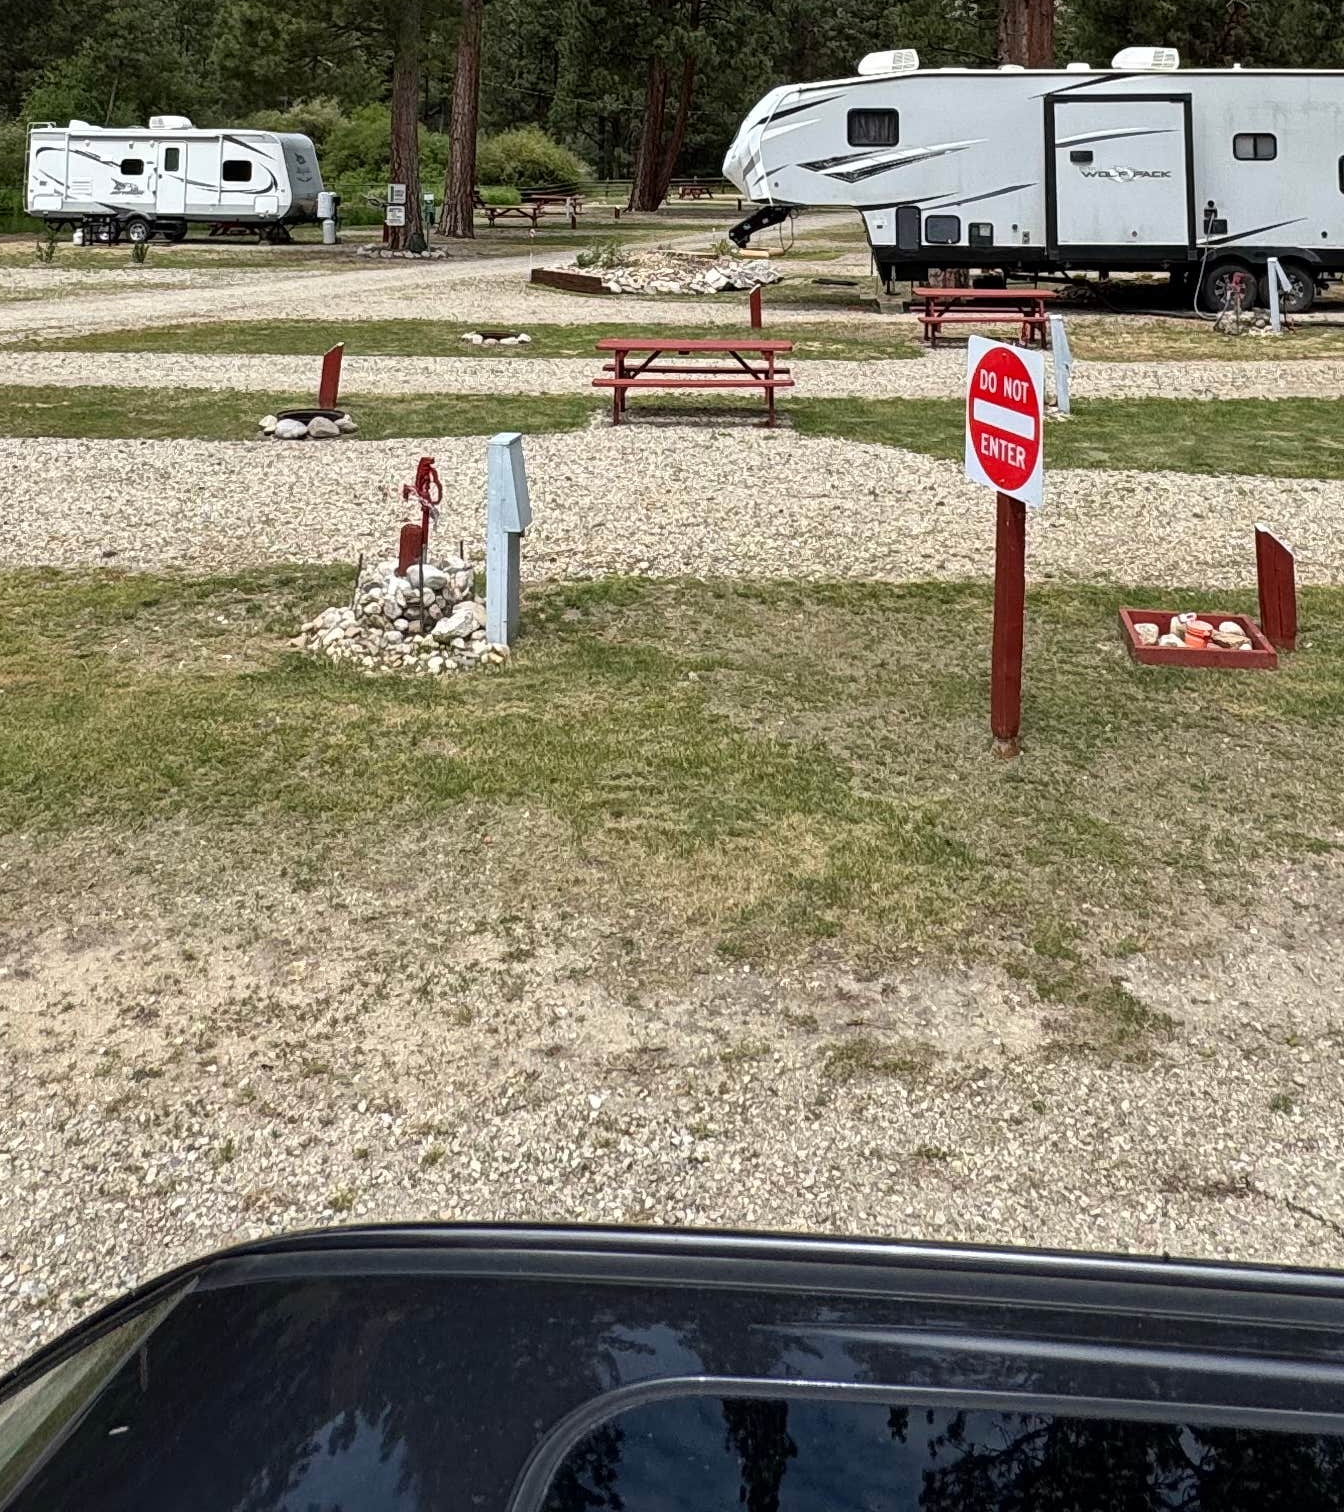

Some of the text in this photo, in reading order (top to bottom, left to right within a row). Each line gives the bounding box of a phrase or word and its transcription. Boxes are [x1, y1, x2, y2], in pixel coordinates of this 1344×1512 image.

[1132, 170, 1172, 178] PACK
[979, 368, 1029, 404] DO NOT
[980, 432, 1026, 470] ENTER
